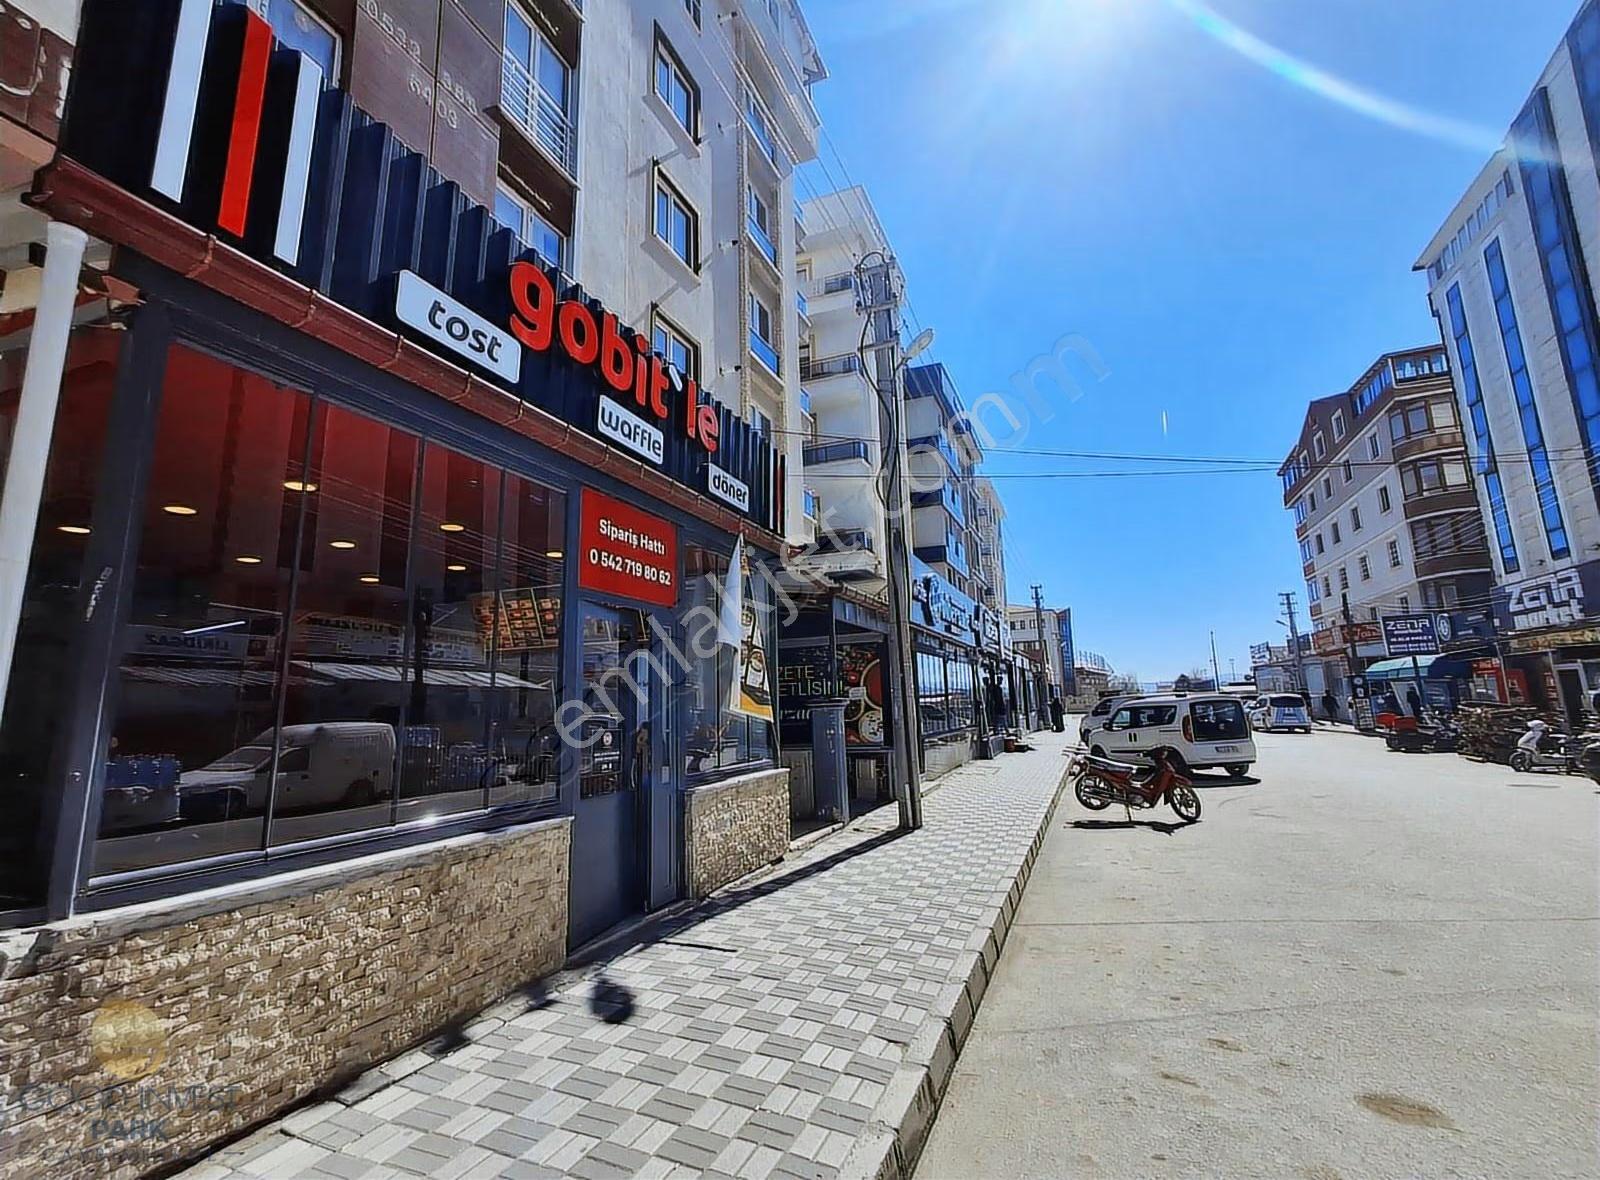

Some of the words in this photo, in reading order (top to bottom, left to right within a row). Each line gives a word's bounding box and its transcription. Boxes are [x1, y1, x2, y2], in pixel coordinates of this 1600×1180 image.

[428, 299, 504, 364] tost
[600, 408, 663, 458] waffle
[712, 473, 746, 504] döner
[599, 518, 639, 549] Sipariş
[639, 533, 665, 555] Hattı
[589, 548, 599, 565] 0
[601, 551, 623, 572] 542
[624, 558, 643, 577] 719
[644, 565, 658, 581] 80
[659, 570, 672, 586] 62
